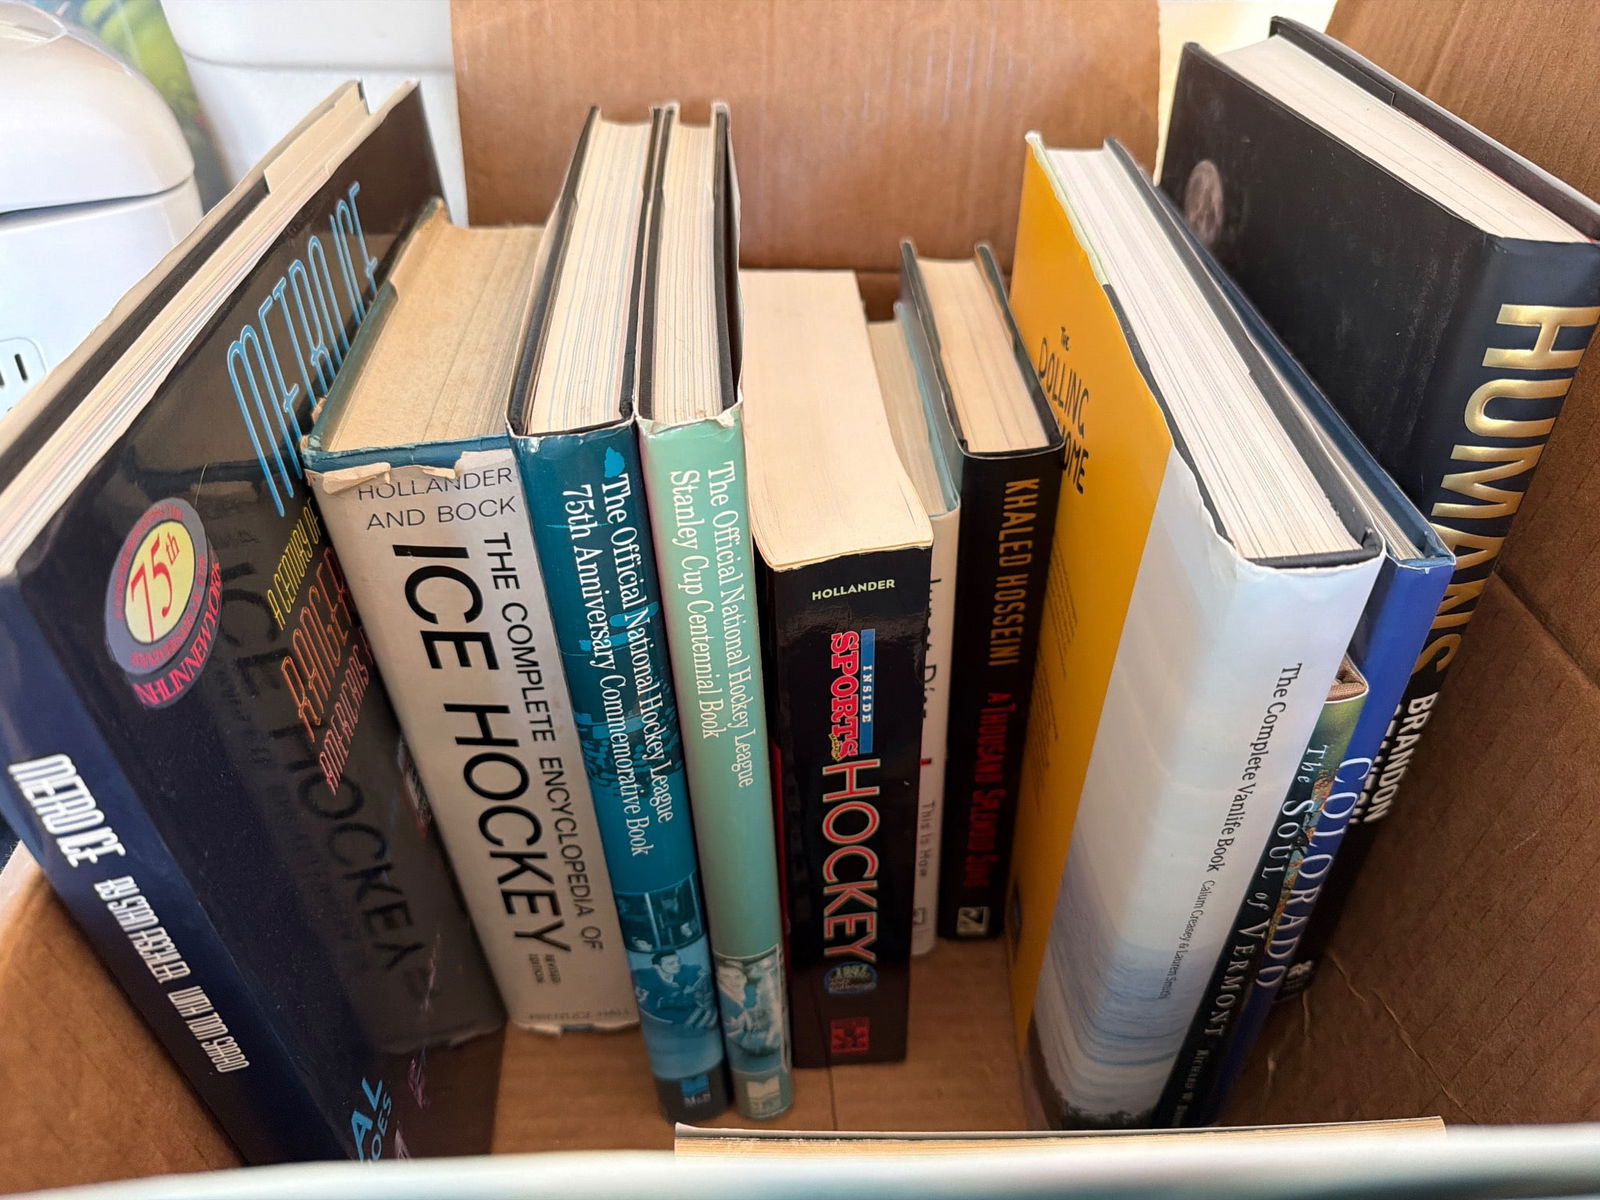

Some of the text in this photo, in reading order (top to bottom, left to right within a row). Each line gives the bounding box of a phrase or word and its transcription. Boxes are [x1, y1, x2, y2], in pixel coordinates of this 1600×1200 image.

[358, 467, 513, 500] HOLLANDER
[366, 495, 517, 531] AND BOCK
[1057, 417, 1089, 495] OME
[130, 531, 180, 643] 75th
[484, 532, 521, 590] THE
[670, 469, 727, 739] Stanley Cup Centennial Book
[811, 579, 896, 600] HOLLANDER
[988, 478, 1040, 667] KHALED HOSSEINI
[281, 547, 352, 743] RANGER
[501, 602, 556, 742] COMPLETE
[562, 483, 655, 857] 75th Anniversary Commemorative Book
[602, 473, 675, 823] The Official National Hockey League
[708, 460, 757, 788] The Official National Hockey League
[1273, 662, 1302, 698] The
[392, 544, 572, 952] ICE HOCKEY
[831, 630, 860, 757] SPORTS
[862, 664, 873, 723] INSIDE
[1243, 701, 1286, 782] Complete
[8, 753, 126, 868] METRO ICE
[1223, 783, 1256, 835] Vanlife
[1363, 692, 1439, 823] BRANDON
[539, 756, 595, 917] ENCYCLOPEDIA
[822, 758, 880, 963] HOCKEY
[1194, 880, 1215, 908] Calum
[1204, 744, 1328, 1037] The SOUL of VERMONT
[1206, 833, 1234, 873] Book
[1254, 757, 1373, 988] COLORADO
[580, 925, 604, 951] OF
[168, 985, 214, 1017] WITH
